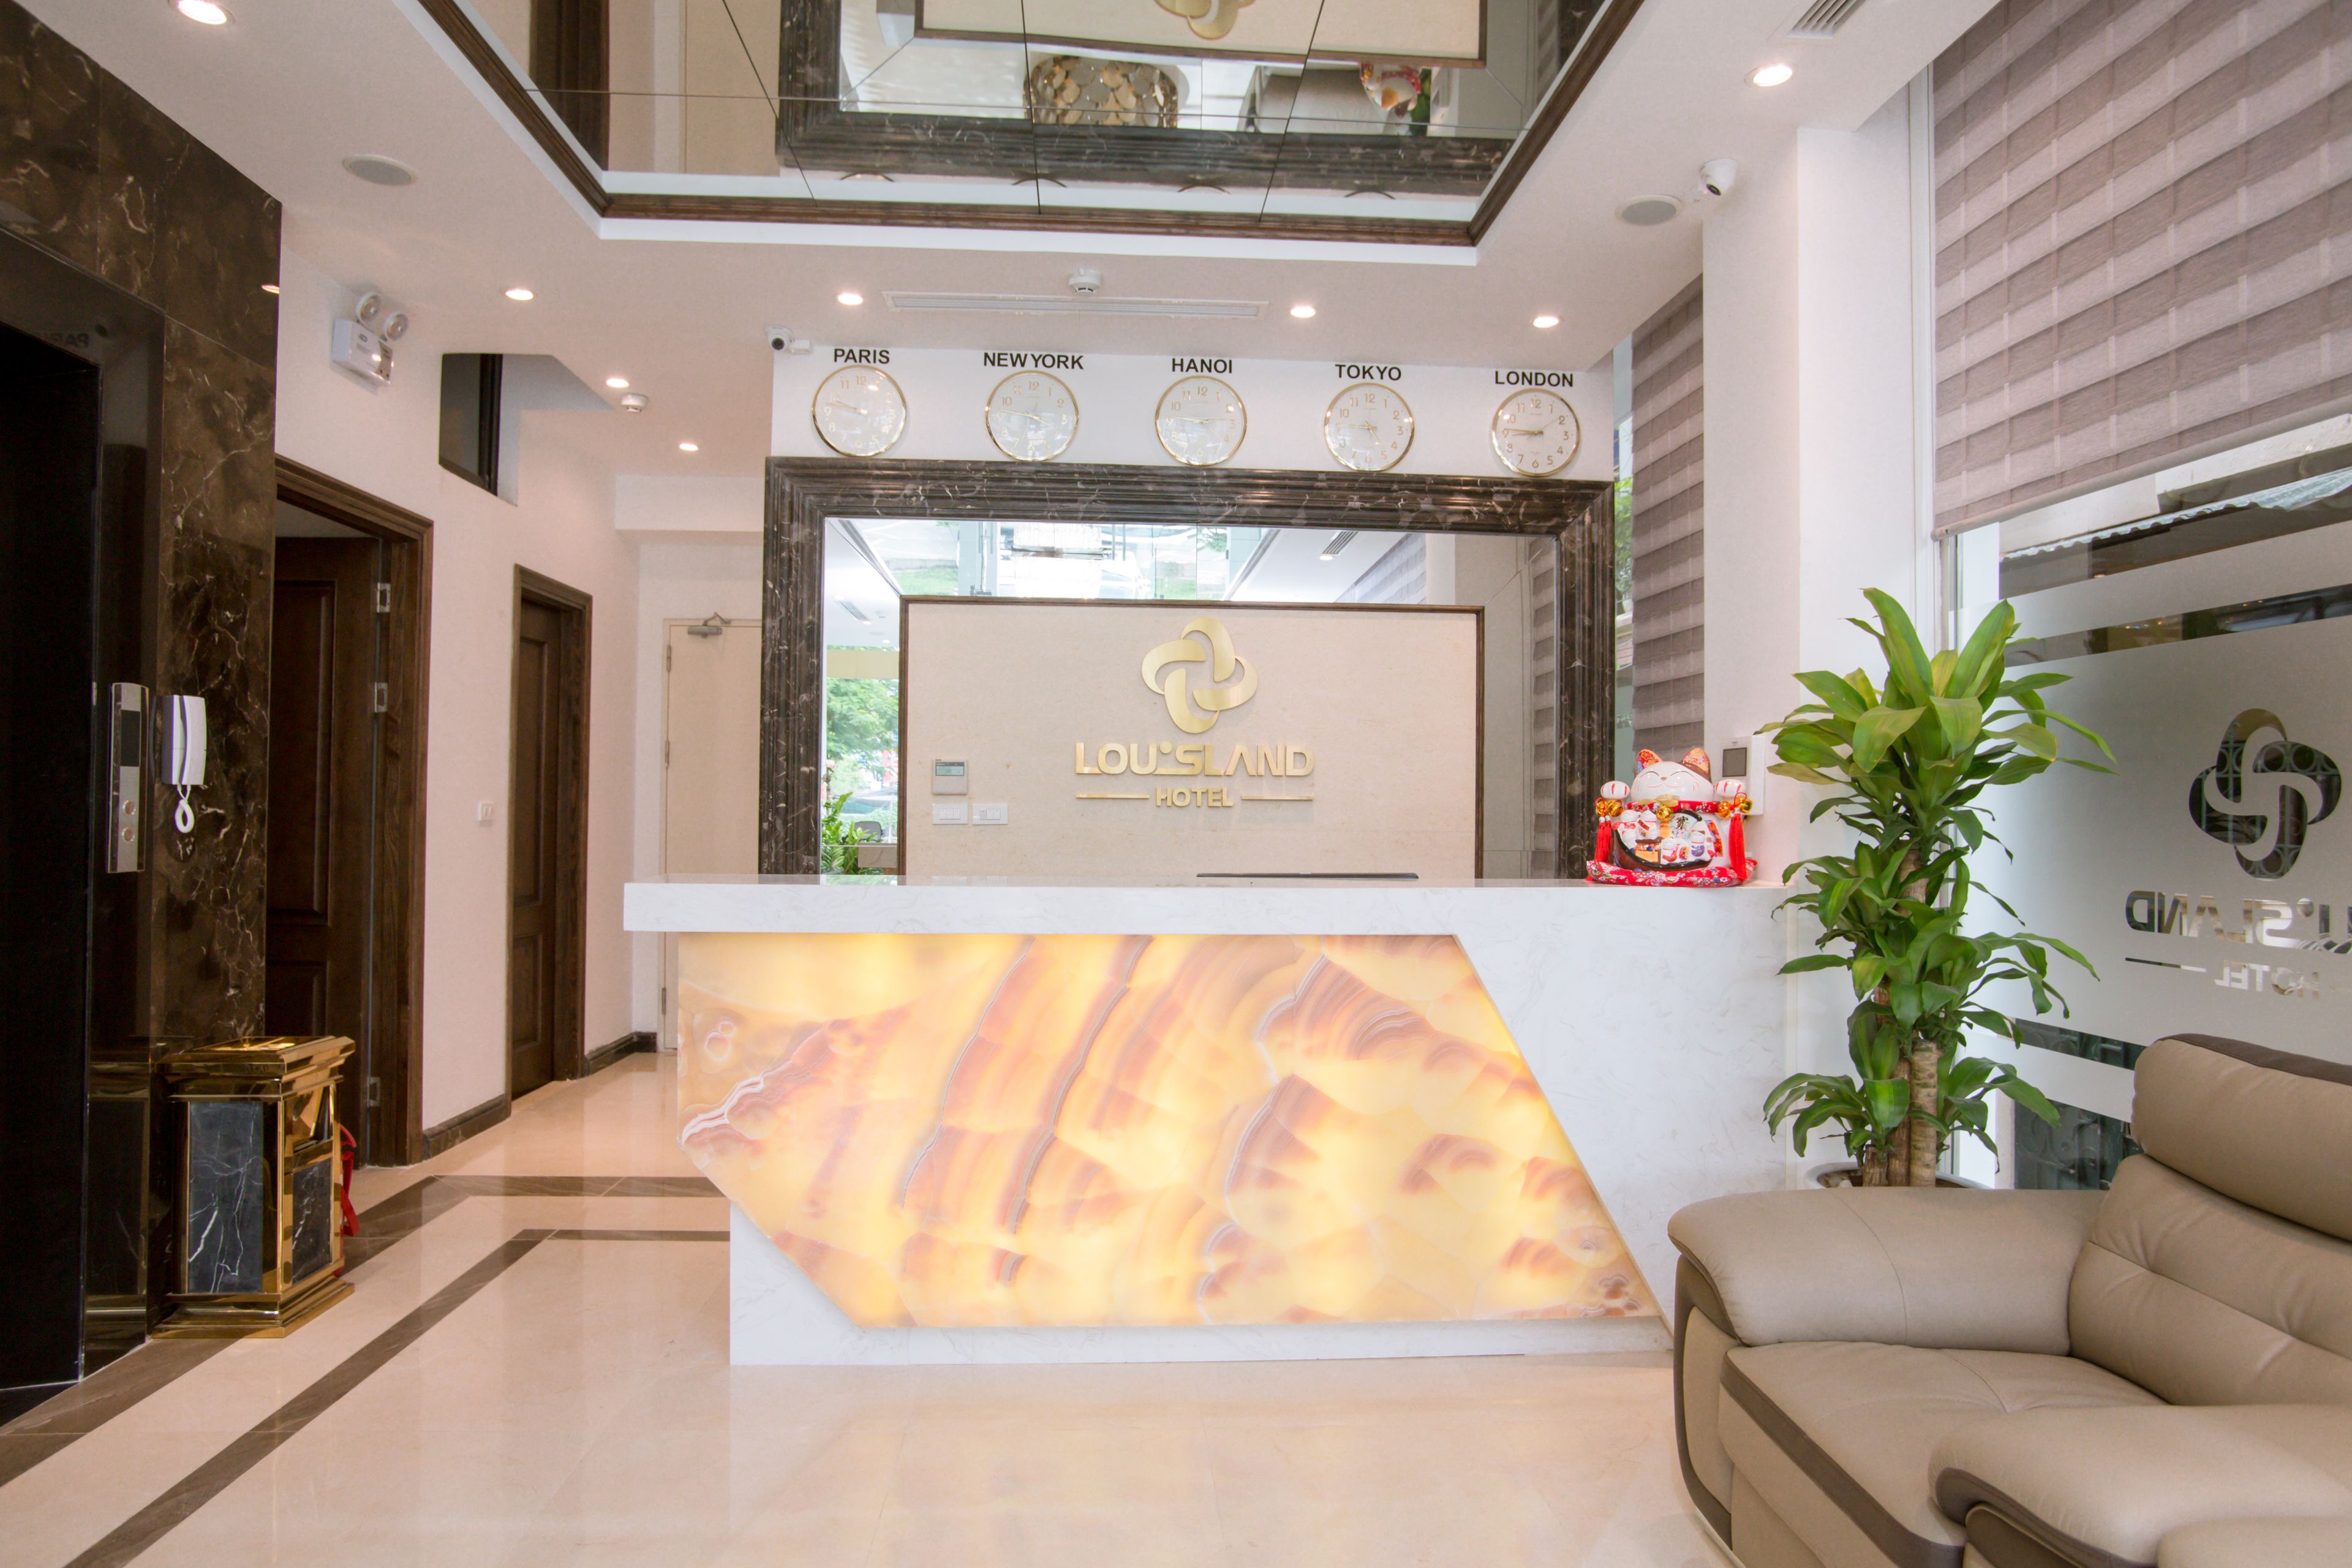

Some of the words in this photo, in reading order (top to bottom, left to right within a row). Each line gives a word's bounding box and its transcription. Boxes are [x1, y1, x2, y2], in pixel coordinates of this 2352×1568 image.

[834, 349, 890, 364] PARIS
[1172, 358, 1232, 374] HANOI
[1335, 364, 1401, 380] TOKYO
[1495, 371, 1573, 387] LONDON
[1028, 381, 1039, 391] 12
[1197, 386, 1208, 396] 12
[1001, 396, 1012, 406] 10
[1057, 399, 1064, 407] 2
[1350, 398, 1359, 407] 11
[1364, 393, 1375, 403] 12
[1170, 401, 1181, 411] 10
[1517, 403, 1525, 413] 11
[1531, 399, 1541, 409] 12
[1339, 409, 1349, 418] 10
[1393, 410, 1400, 420] 2
[1559, 416, 1565, 425] 2
[1397, 426, 1403, 435] 3
[1502, 428, 1509, 438] 9
[1563, 431, 1569, 440] 3
[1391, 441, 1397, 450] 4
[1507, 443, 1513, 453] 8
[1557, 446, 1563, 454] 4
[1381, 451, 1387, 459] 5
[1518, 454, 1524, 464] 7
[1532, 459, 1539, 469] 6
[1547, 456, 1553, 465] 5
[1156, 787, 1235, 807] HOTEL
